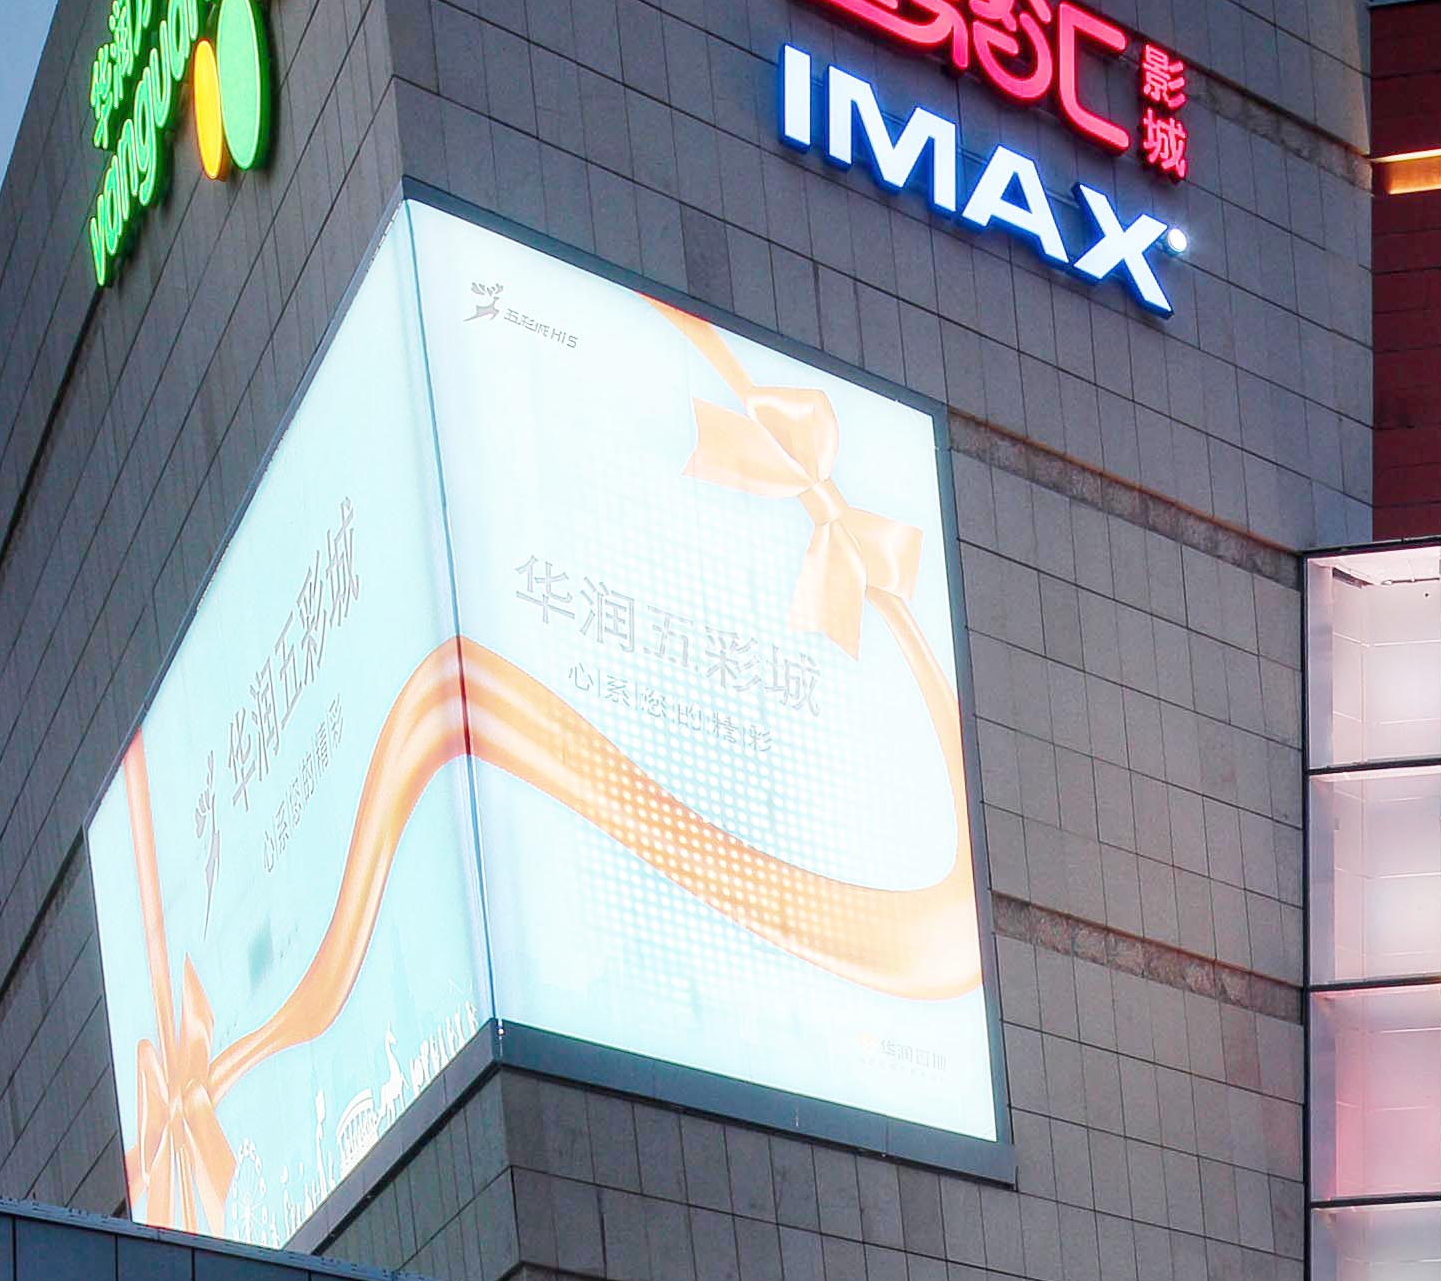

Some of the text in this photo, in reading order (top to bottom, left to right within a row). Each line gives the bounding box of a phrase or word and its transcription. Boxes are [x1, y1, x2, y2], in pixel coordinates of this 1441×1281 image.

[780, 42, 1175, 318] IMAX
[1140, 42, 1189, 179] 影城
[228, 496, 360, 812] 华润五彩城
[515, 555, 822, 717] 华润五彩城
